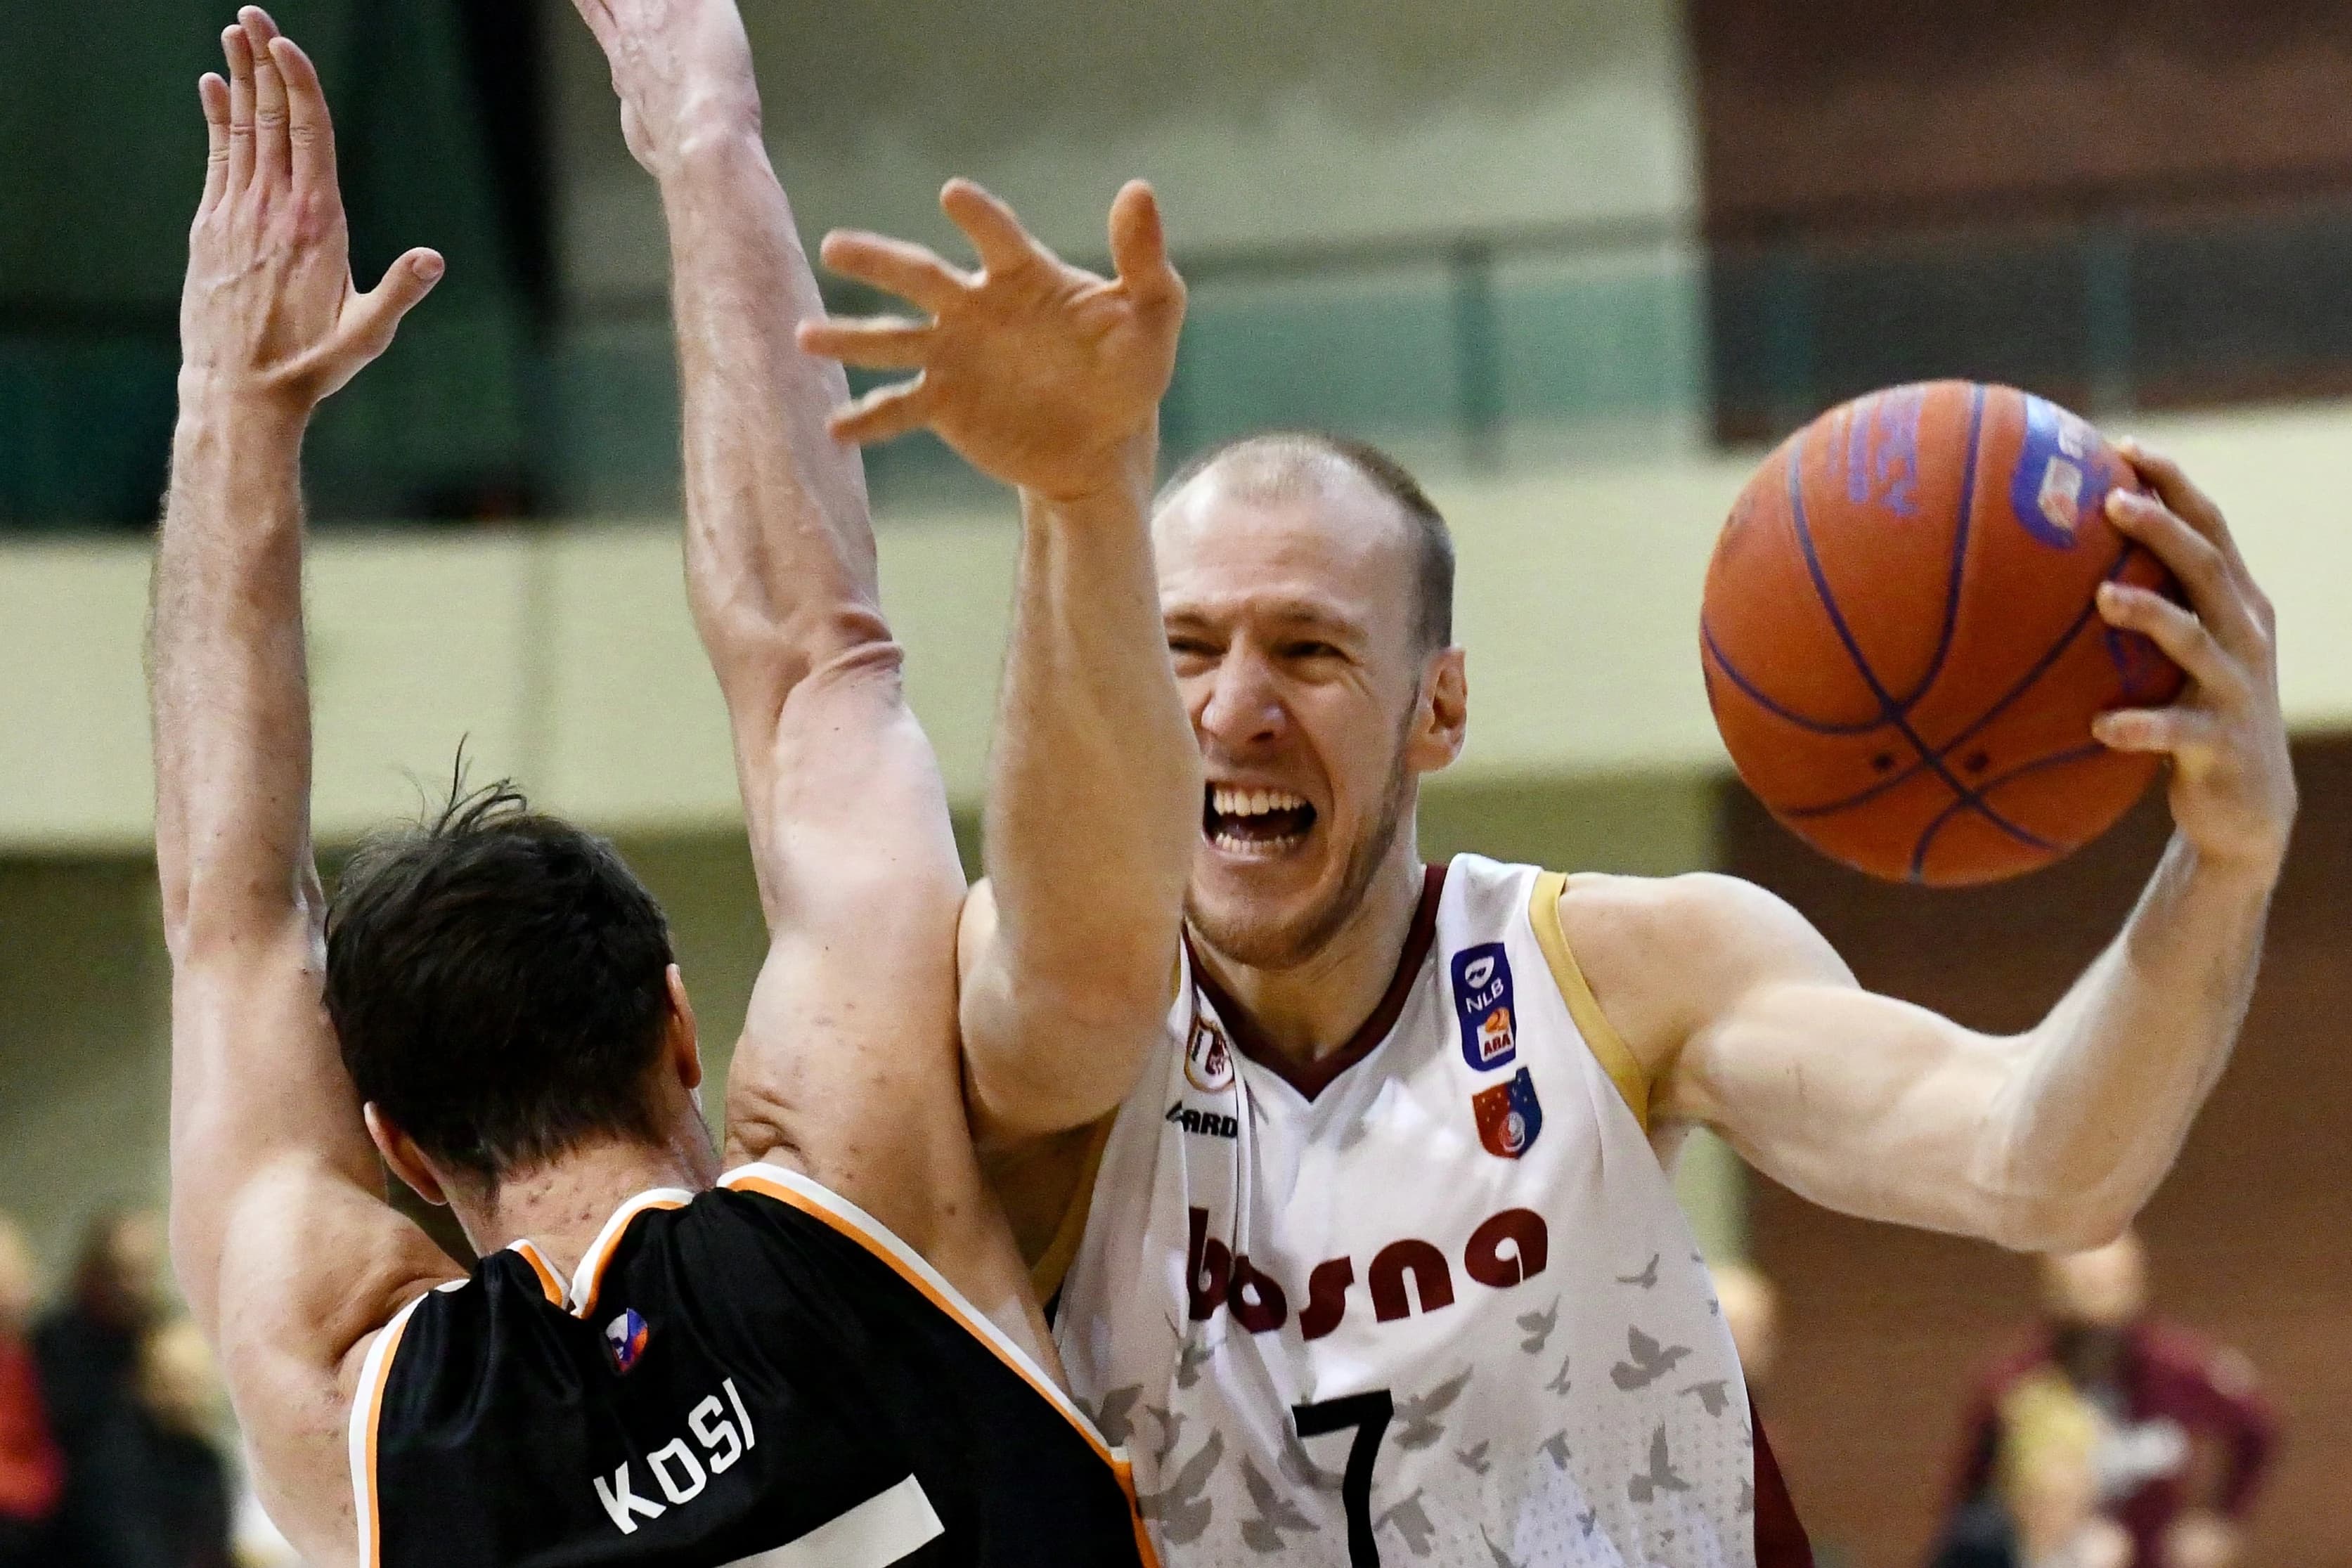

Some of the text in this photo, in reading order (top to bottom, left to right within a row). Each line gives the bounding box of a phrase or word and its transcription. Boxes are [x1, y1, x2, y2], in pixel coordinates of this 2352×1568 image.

[1466, 977, 1504, 1013] NLB
[1484, 1034, 1511, 1056] ABA
[1187, 1207, 1548, 1342] bosna
[593, 1377, 755, 1535] KOSI
[1292, 1390, 1394, 1568] 7
